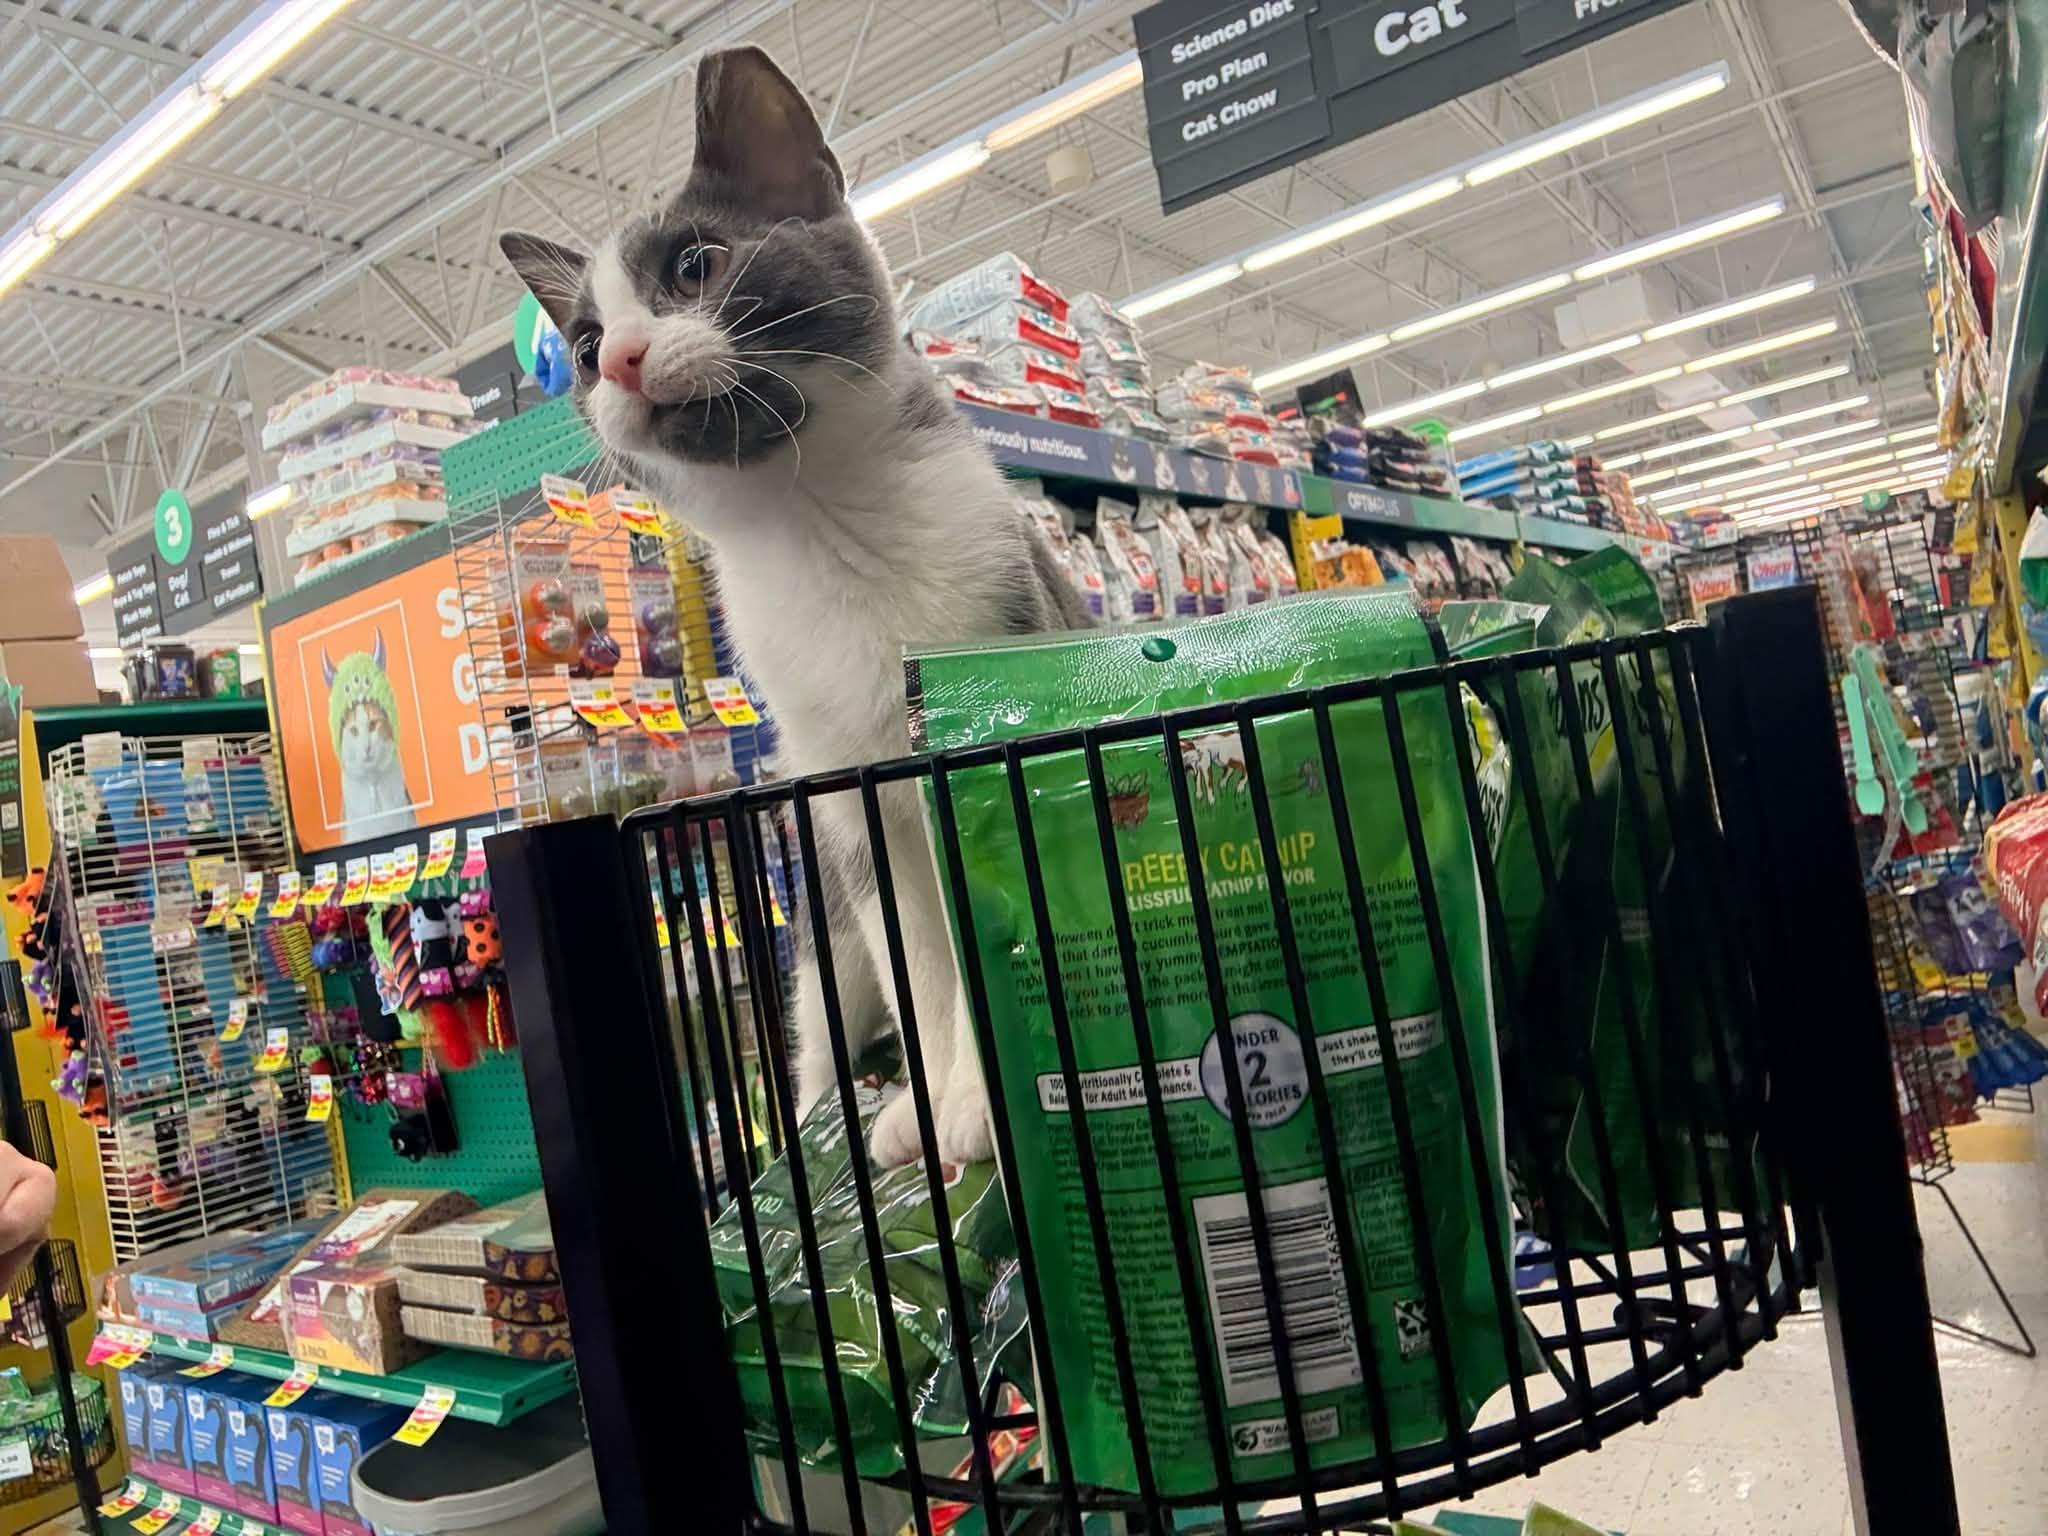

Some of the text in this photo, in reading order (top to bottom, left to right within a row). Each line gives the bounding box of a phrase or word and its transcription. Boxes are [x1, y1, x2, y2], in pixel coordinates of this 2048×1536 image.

[1170, 0, 1295, 63] Science Diet
[1373, 0, 1469, 56] Cat
[1181, 51, 1268, 101] Pro Plan
[1181, 89, 1278, 141] Cat Chow
[164, 505, 183, 548] 3
[1127, 887, 1193, 912] LISSFUL
[1208, 876, 1253, 898] ATNIP
[1235, 1028, 1280, 1048] NDER
[1321, 1041, 1345, 1053] Just
[1331, 1046, 1366, 1066] they'll
[1079, 1074, 1132, 1089] utritionally
[1244, 1050, 1271, 1087] 2
[1084, 1091, 1098, 1104] for
[1101, 1088, 1128, 1103] Adult
